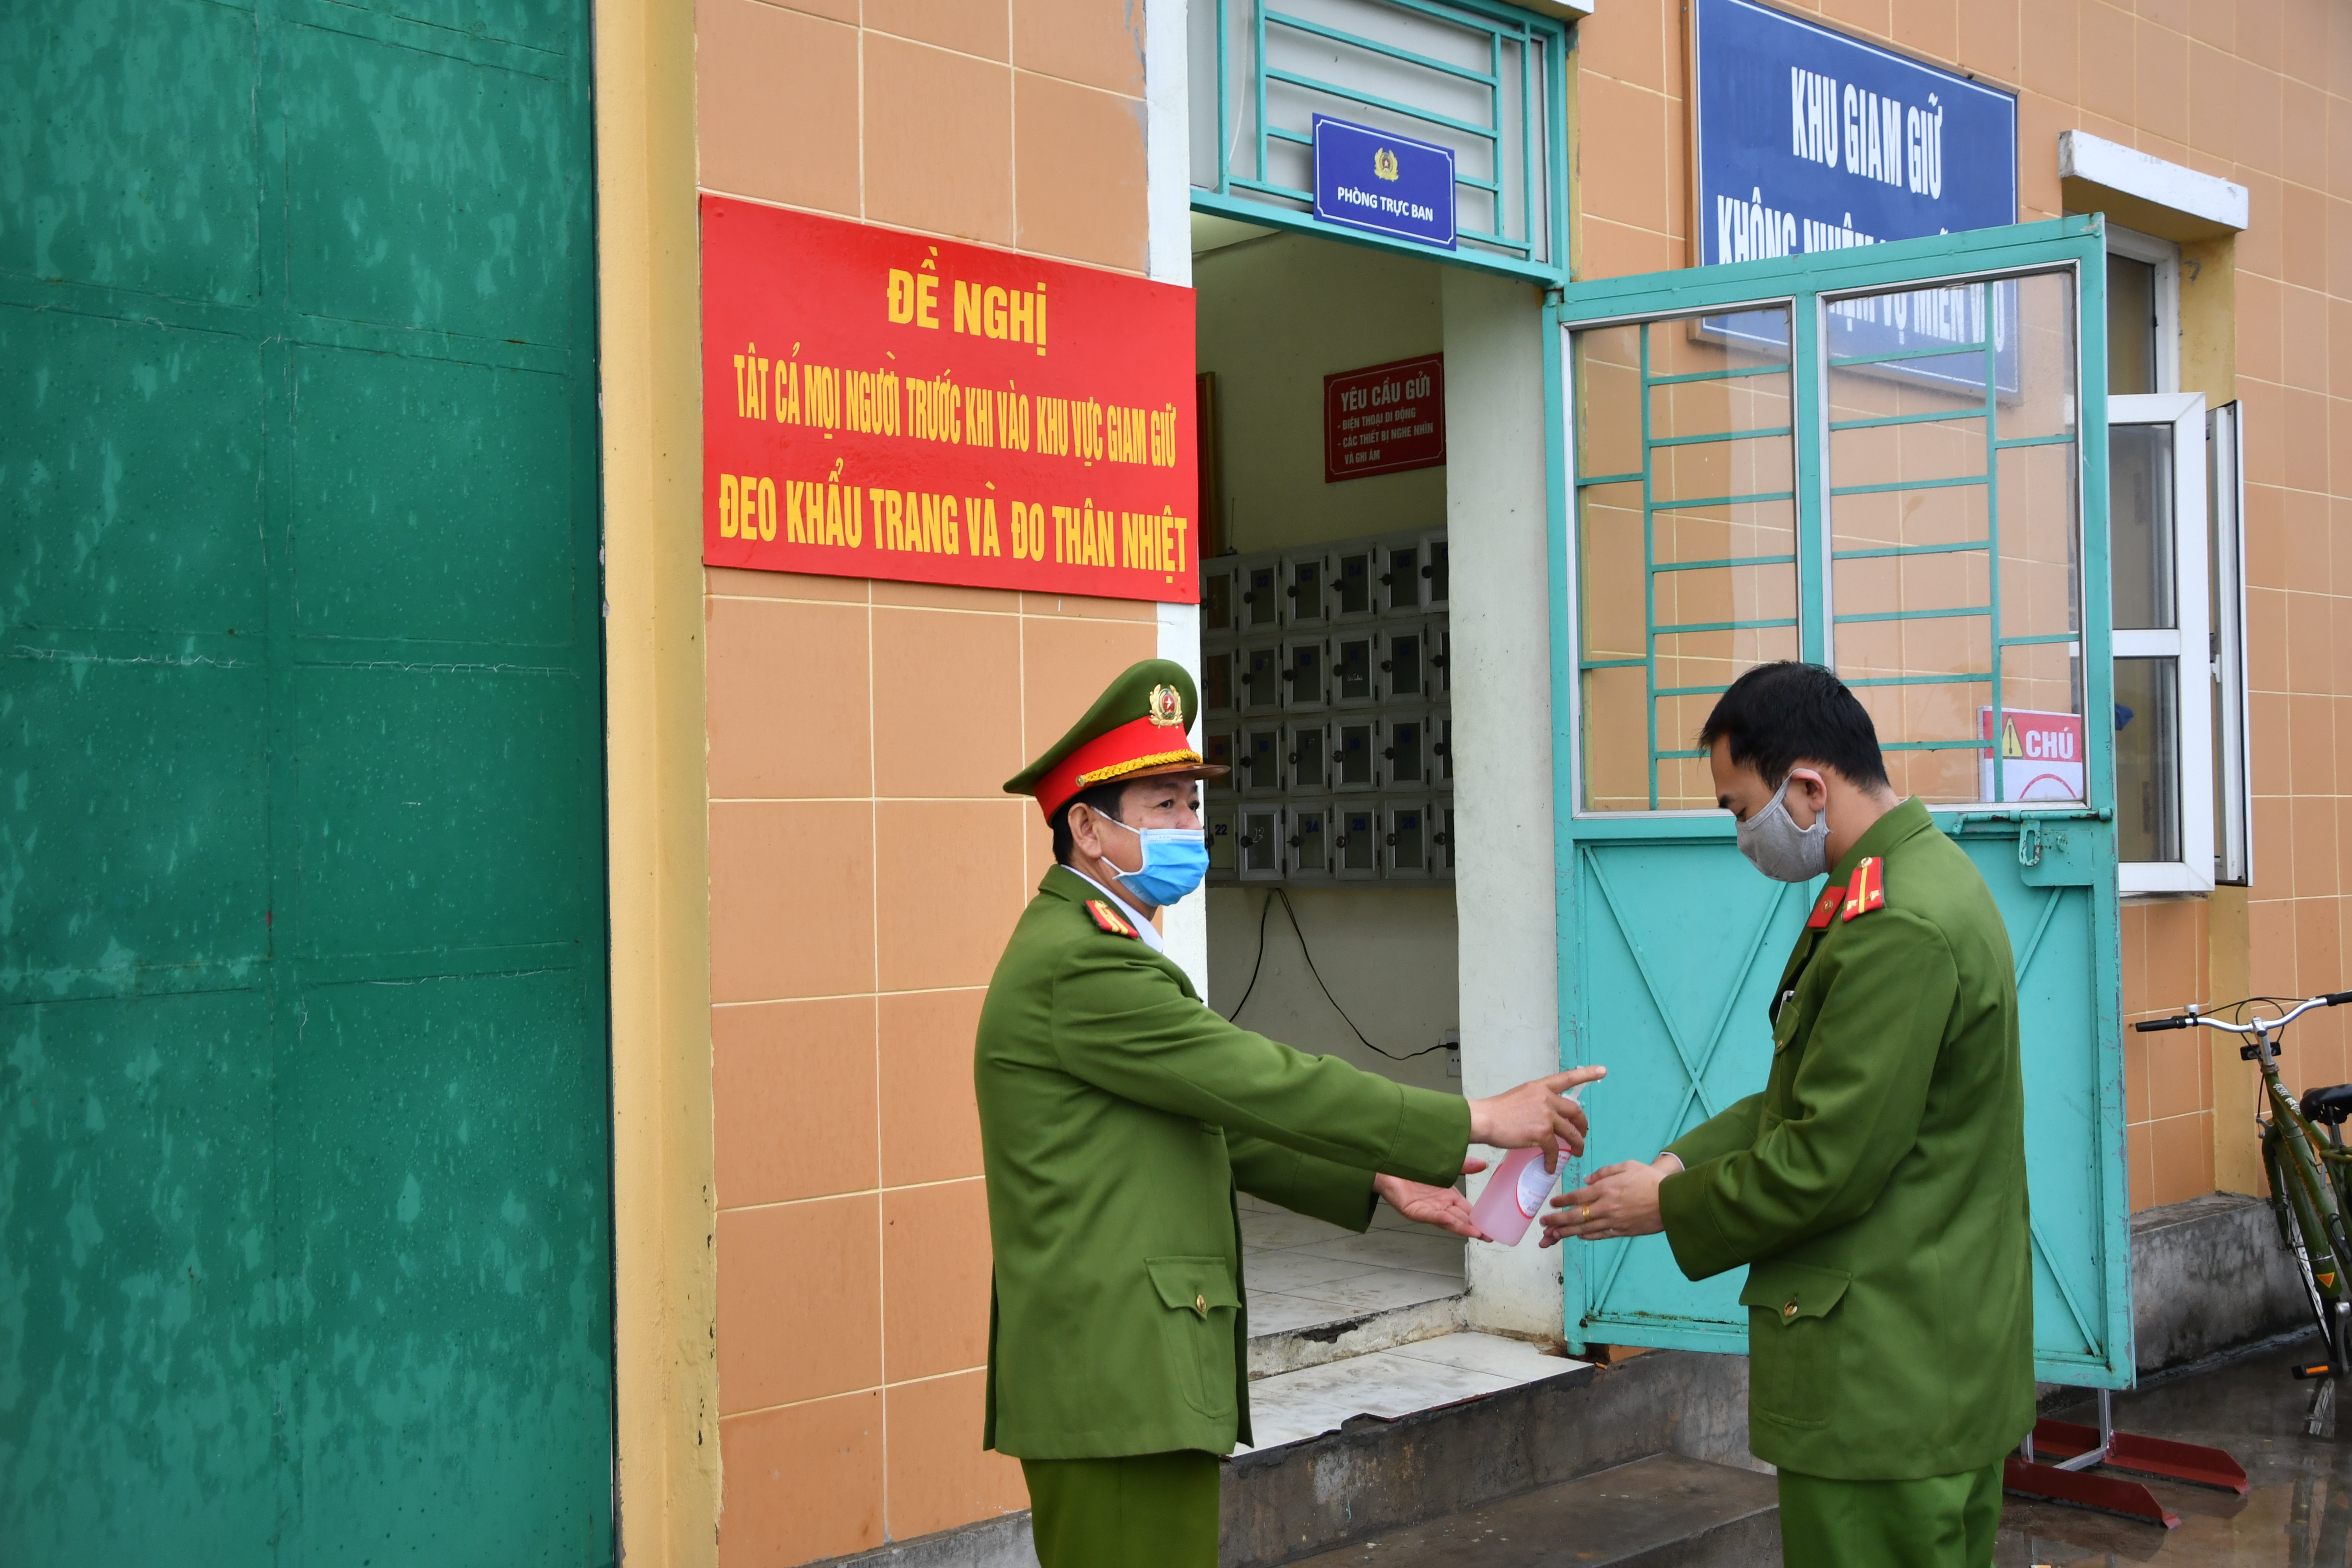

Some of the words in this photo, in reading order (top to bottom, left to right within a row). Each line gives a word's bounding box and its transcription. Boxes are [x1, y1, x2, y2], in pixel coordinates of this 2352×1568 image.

[1792, 67, 1838, 168] KHU
[1844, 84, 1901, 187] GIAM
[1908, 93, 1942, 199] GIỮ
[1338, 187, 1377, 209] PHÒNG
[1380, 196, 1409, 216] TRỰC
[1411, 204, 1433, 222] BAN
[887, 247, 939, 329] ĐỀ
[954, 280, 1046, 356] NGHỊ
[775, 342, 800, 424] CẢ
[804, 365, 840, 439] MỌI
[846, 351, 901, 436] NGƯỜI
[906, 369, 961, 444] TRƯỚC
[965, 387, 993, 447] KHI
[997, 380, 1029, 452] VÀO
[1037, 396, 1068, 456] KHU
[1071, 397, 1103, 466] VỰC
[1107, 405, 1146, 464] GIAM
[1151, 403, 1176, 468] GIỮ
[1341, 386, 1367, 412] YÊU
[1372, 377, 1400, 406] CẦU
[1405, 370, 1430, 400] GỬI
[1342, 416, 1360, 431] ĐIỆN
[1361, 413, 1383, 427] THOẠI
[1386, 412, 1393, 422] DI
[1395, 407, 1416, 422] ĐỘNG
[1343, 434, 1358, 448] CÁC
[1360, 429, 1379, 445] THIẾT
[1381, 430, 1389, 443] BỊ
[1391, 426, 1411, 439] NGHE
[1414, 421, 1433, 436] NHÌN
[1345, 452, 1354, 465] VÀ
[1356, 451, 1367, 463] GHI
[1369, 449, 1380, 461] ÂM
[719, 474, 776, 542] ĐEO
[787, 457, 862, 548] KHẨU
[870, 488, 959, 555] TRANG
[965, 481, 1001, 557] VÀ
[1011, 501, 1044, 561] ĐO
[1052, 498, 1115, 567] THÂN
[1122, 505, 1187, 583] NHIỆT
[2025, 727, 2074, 759] CHÚ
[1215, 824, 1227, 836] 22
[1306, 820, 1318, 833] 24
[1353, 819, 1365, 831] 25
[1402, 817, 1416, 829] 26
